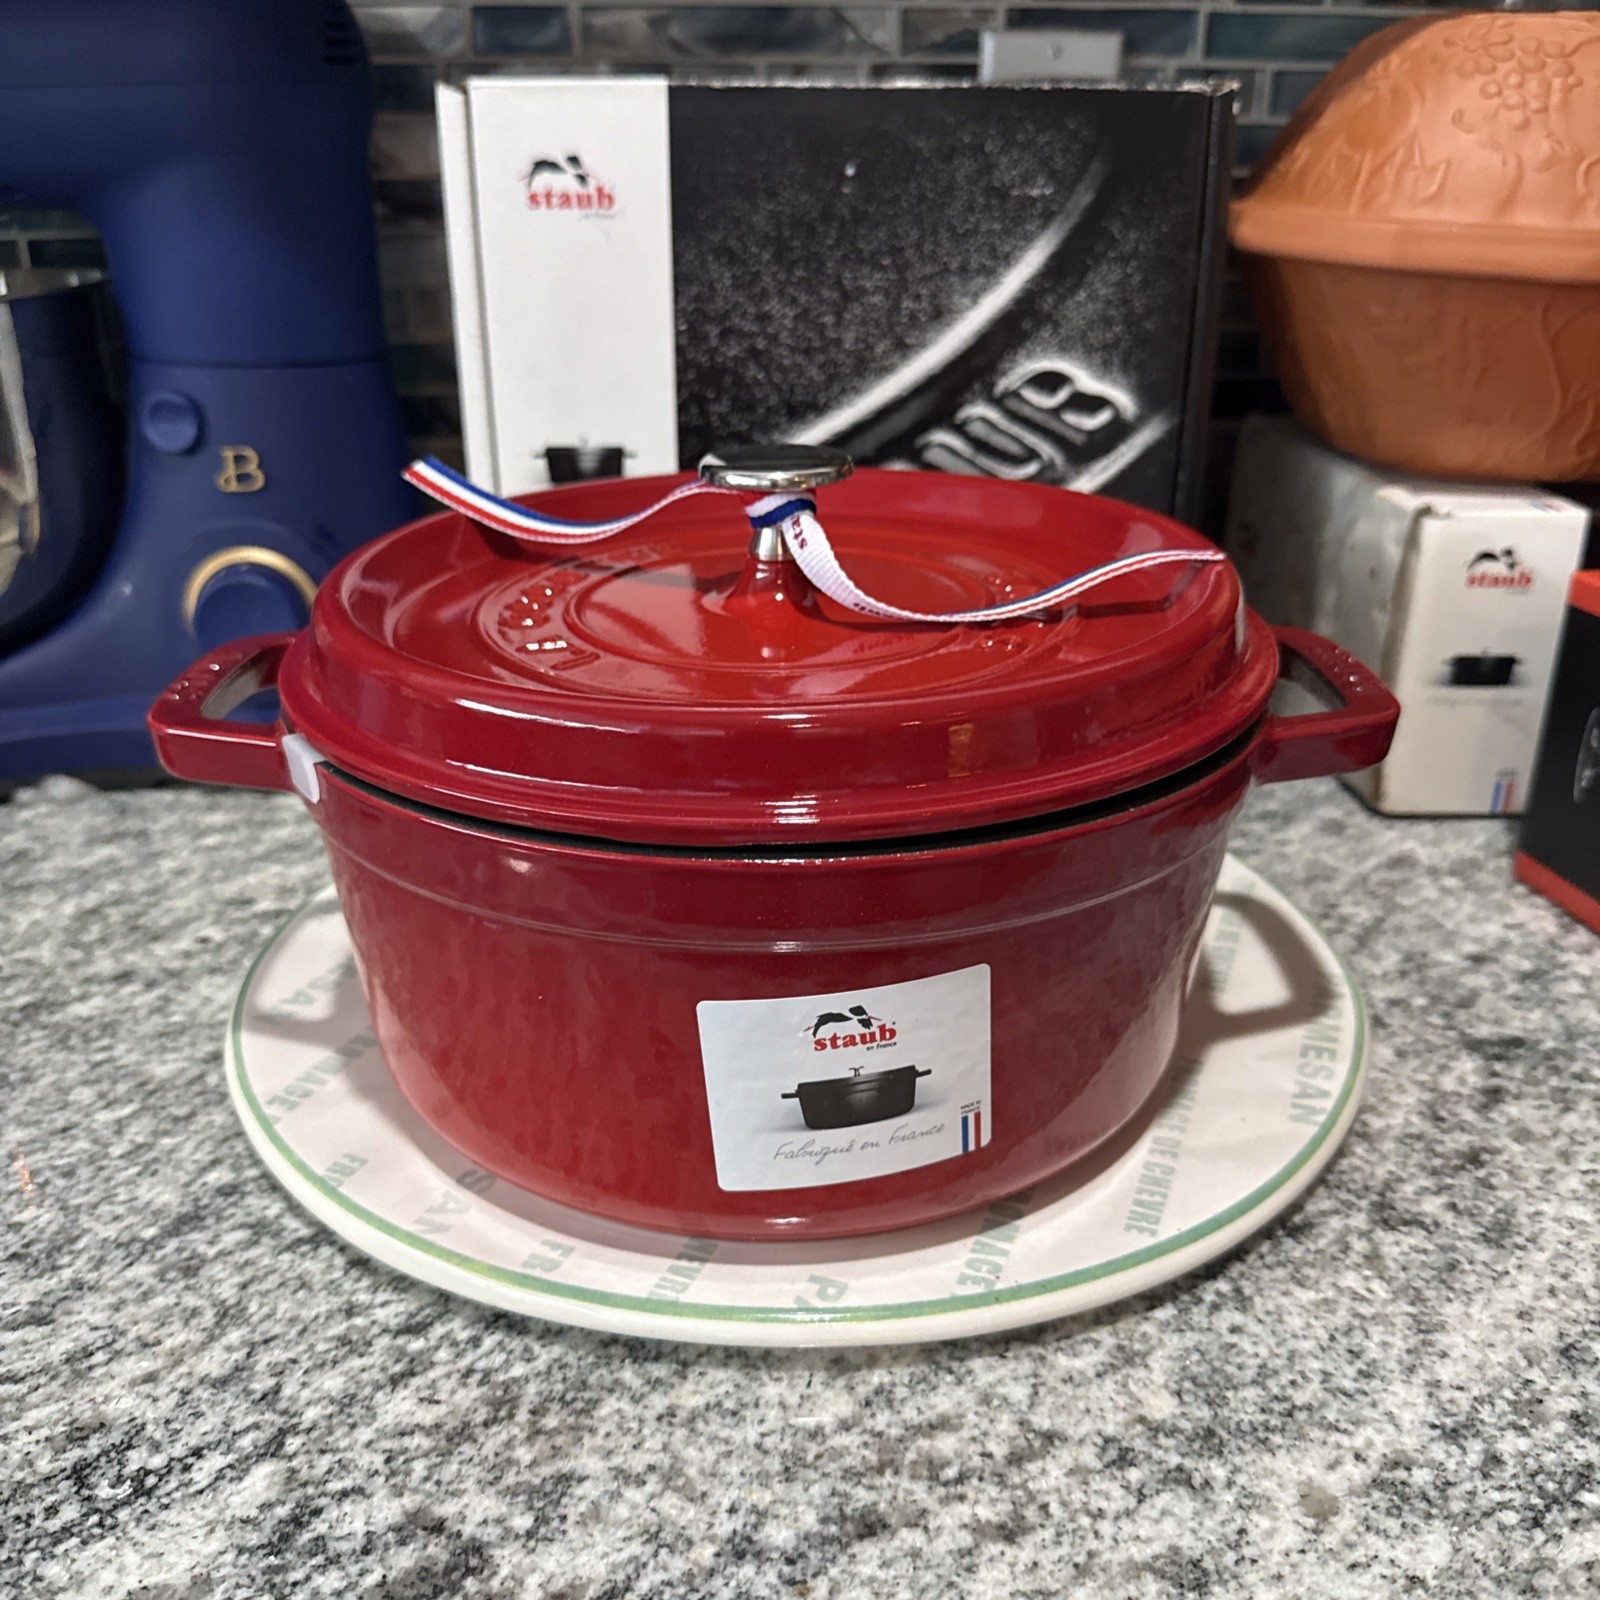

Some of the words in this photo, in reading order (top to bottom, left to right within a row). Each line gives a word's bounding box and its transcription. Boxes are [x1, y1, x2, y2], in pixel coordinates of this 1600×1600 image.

[529, 187, 616, 211] staub
[214, 444, 266, 493] B
[814, 1023, 897, 1052] staub
[876, 1041, 898, 1050] France
[859, 1141, 881, 1151] en
[887, 1123, 946, 1146] France
[1123, 1161, 1176, 1238] CHEVRE
